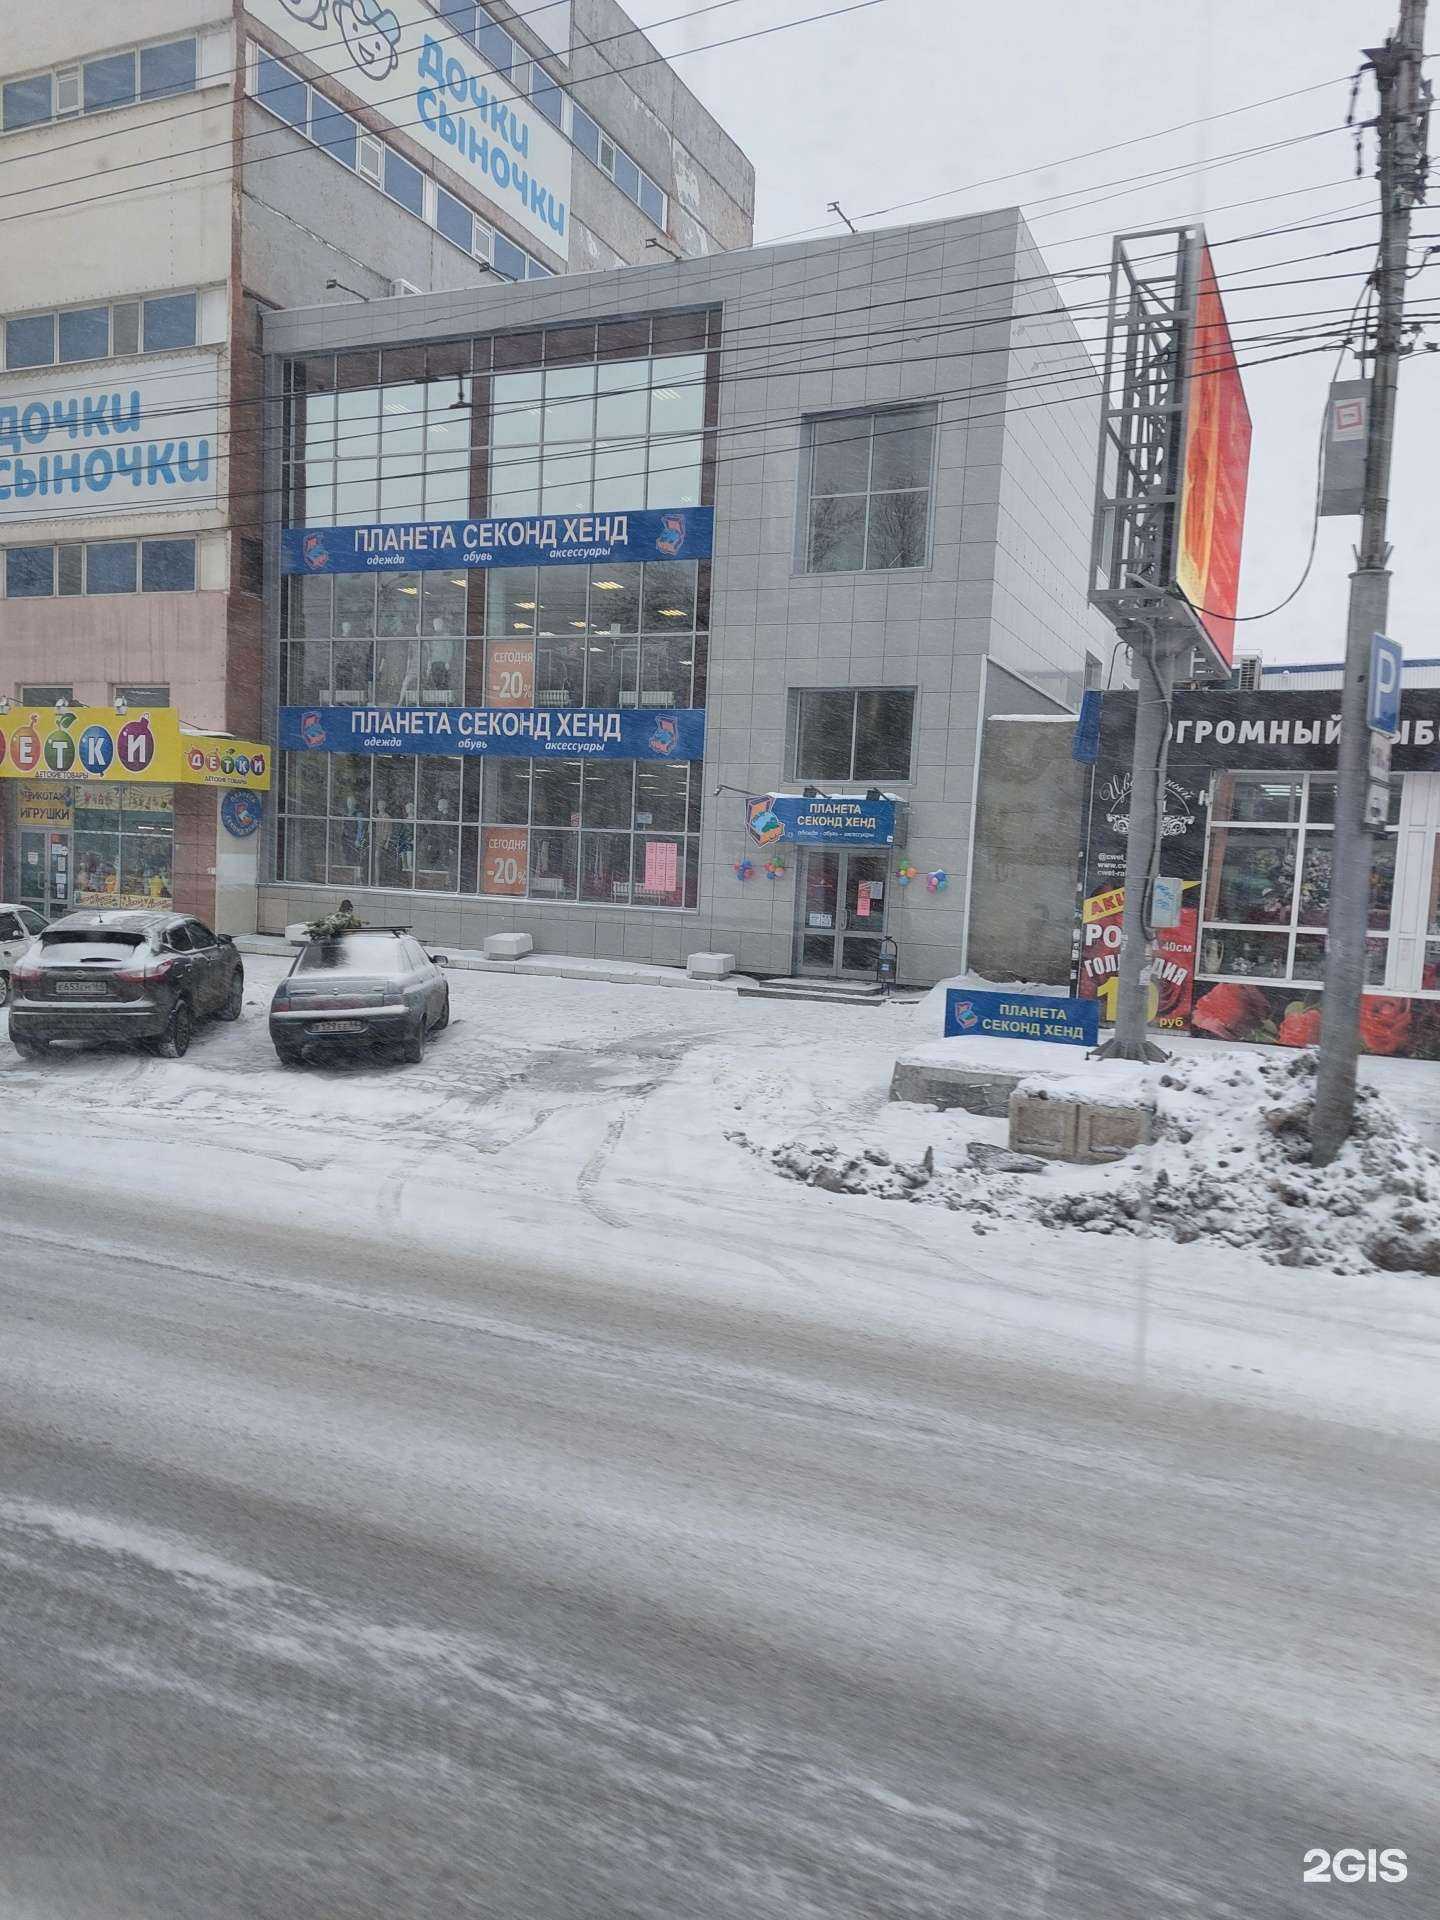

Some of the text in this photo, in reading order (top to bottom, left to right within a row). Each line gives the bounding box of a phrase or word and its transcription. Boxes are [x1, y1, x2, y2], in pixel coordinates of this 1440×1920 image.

[354, 515, 629, 552] ПЛАНЕТА СЕКОНД ХЕНД
[366, 546, 611, 566] одежда обувь аксессуары
[494, 651, 533, 665] СЕГОДНЯ
[351, 711, 622, 742] ПЛАНЕТА СЕКОНД ХЕНД
[364, 736, 605, 754] одежда обувь аксессуары
[192, 755, 263, 771] ДЕТКИ
[20, 807, 70, 819] ИГРУШКИ
[809, 803, 861, 815] ПЛАНЕТА
[797, 816, 876, 829] СЕКОНД ХЕНД
[488, 838, 528, 851] СЕГОДНЯ
[1000, 1004, 1067, 1020] ПЛАНЕТА
[982, 1018, 1084, 1040] СЕКОНД ХЕНД
